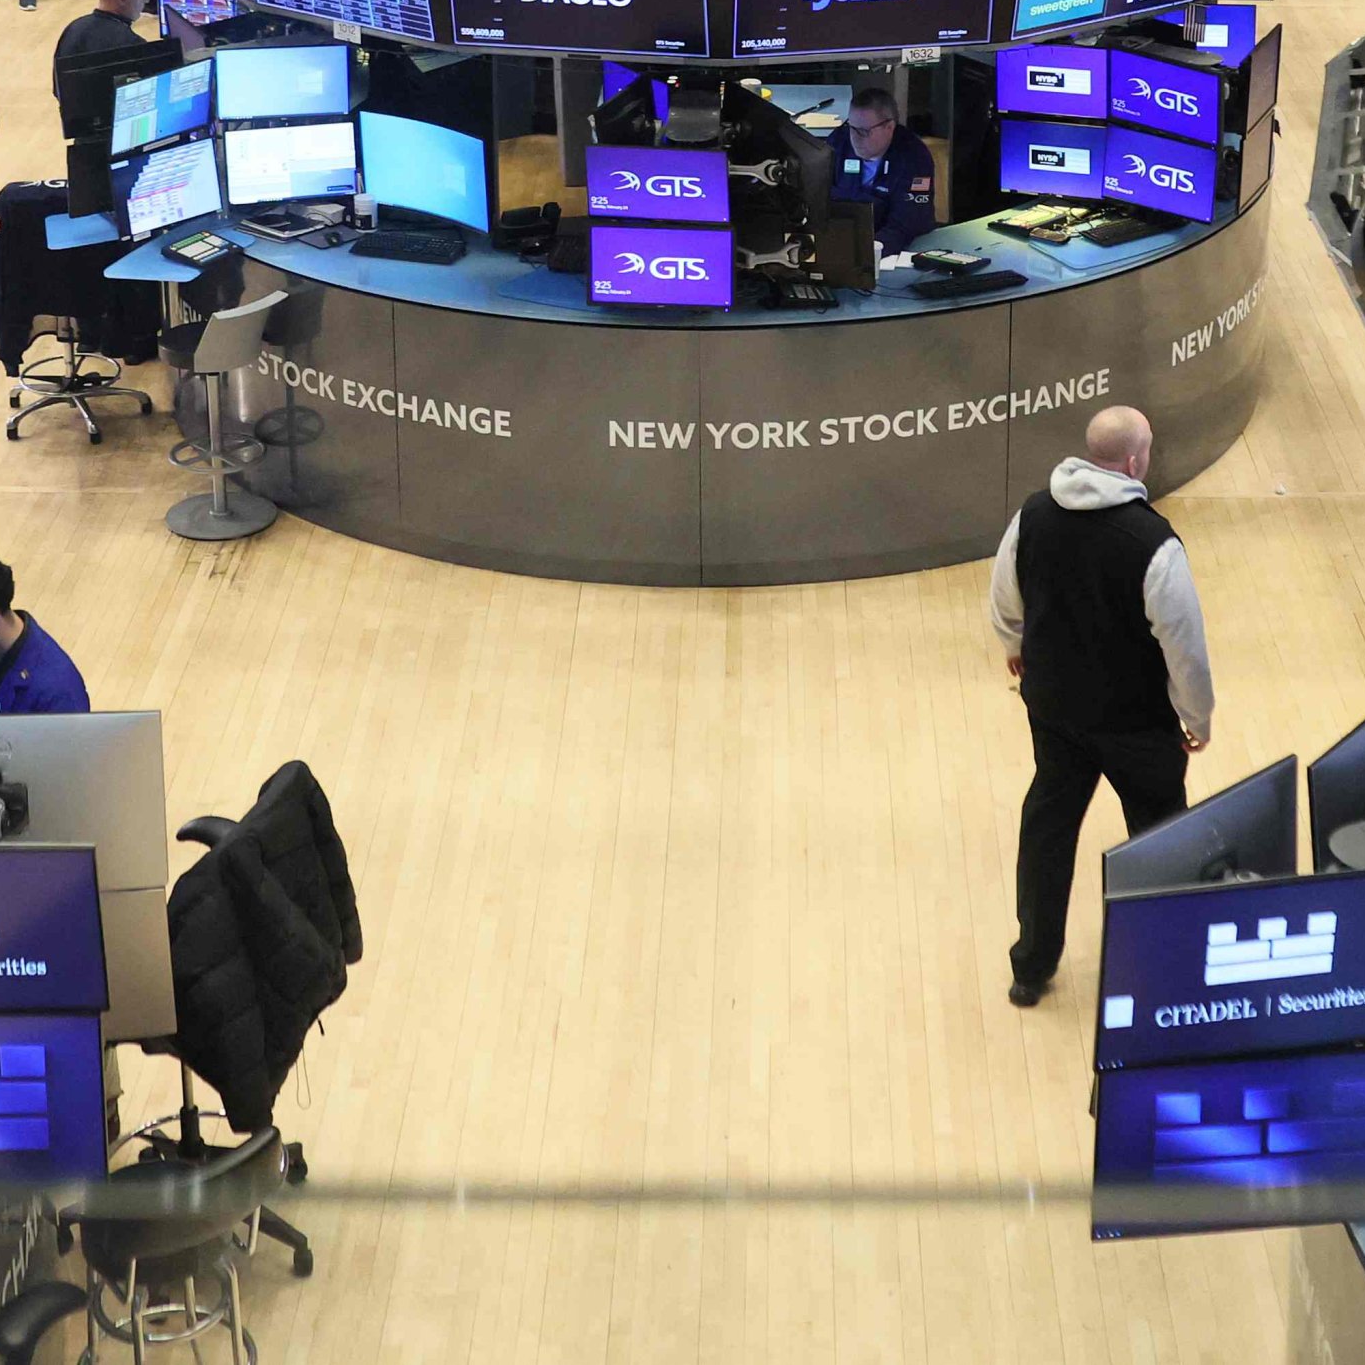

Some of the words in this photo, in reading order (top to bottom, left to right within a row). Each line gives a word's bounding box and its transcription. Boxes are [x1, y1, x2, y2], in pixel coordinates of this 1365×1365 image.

[908, 49, 934, 59] 1632
[1154, 88, 1198, 117] GTS
[645, 175, 703, 198] GTS
[1149, 164, 1194, 193] GTS
[590, 196, 609, 206] 9:25
[649, 256, 706, 281] GTS
[594, 281, 612, 290] 9:25
[1171, 326, 1215, 367] NEW
[1216, 292, 1251, 339] YORK
[257, 349, 336, 401] STOCK
[341, 379, 512, 438] EXCHANGE
[608, 420, 695, 450] NEW
[705, 420, 809, 450] YORK
[819, 406, 939, 446] STOCK
[947, 367, 1111, 431] EXCHANGE
[1155, 997, 1257, 1029] CITADEL
